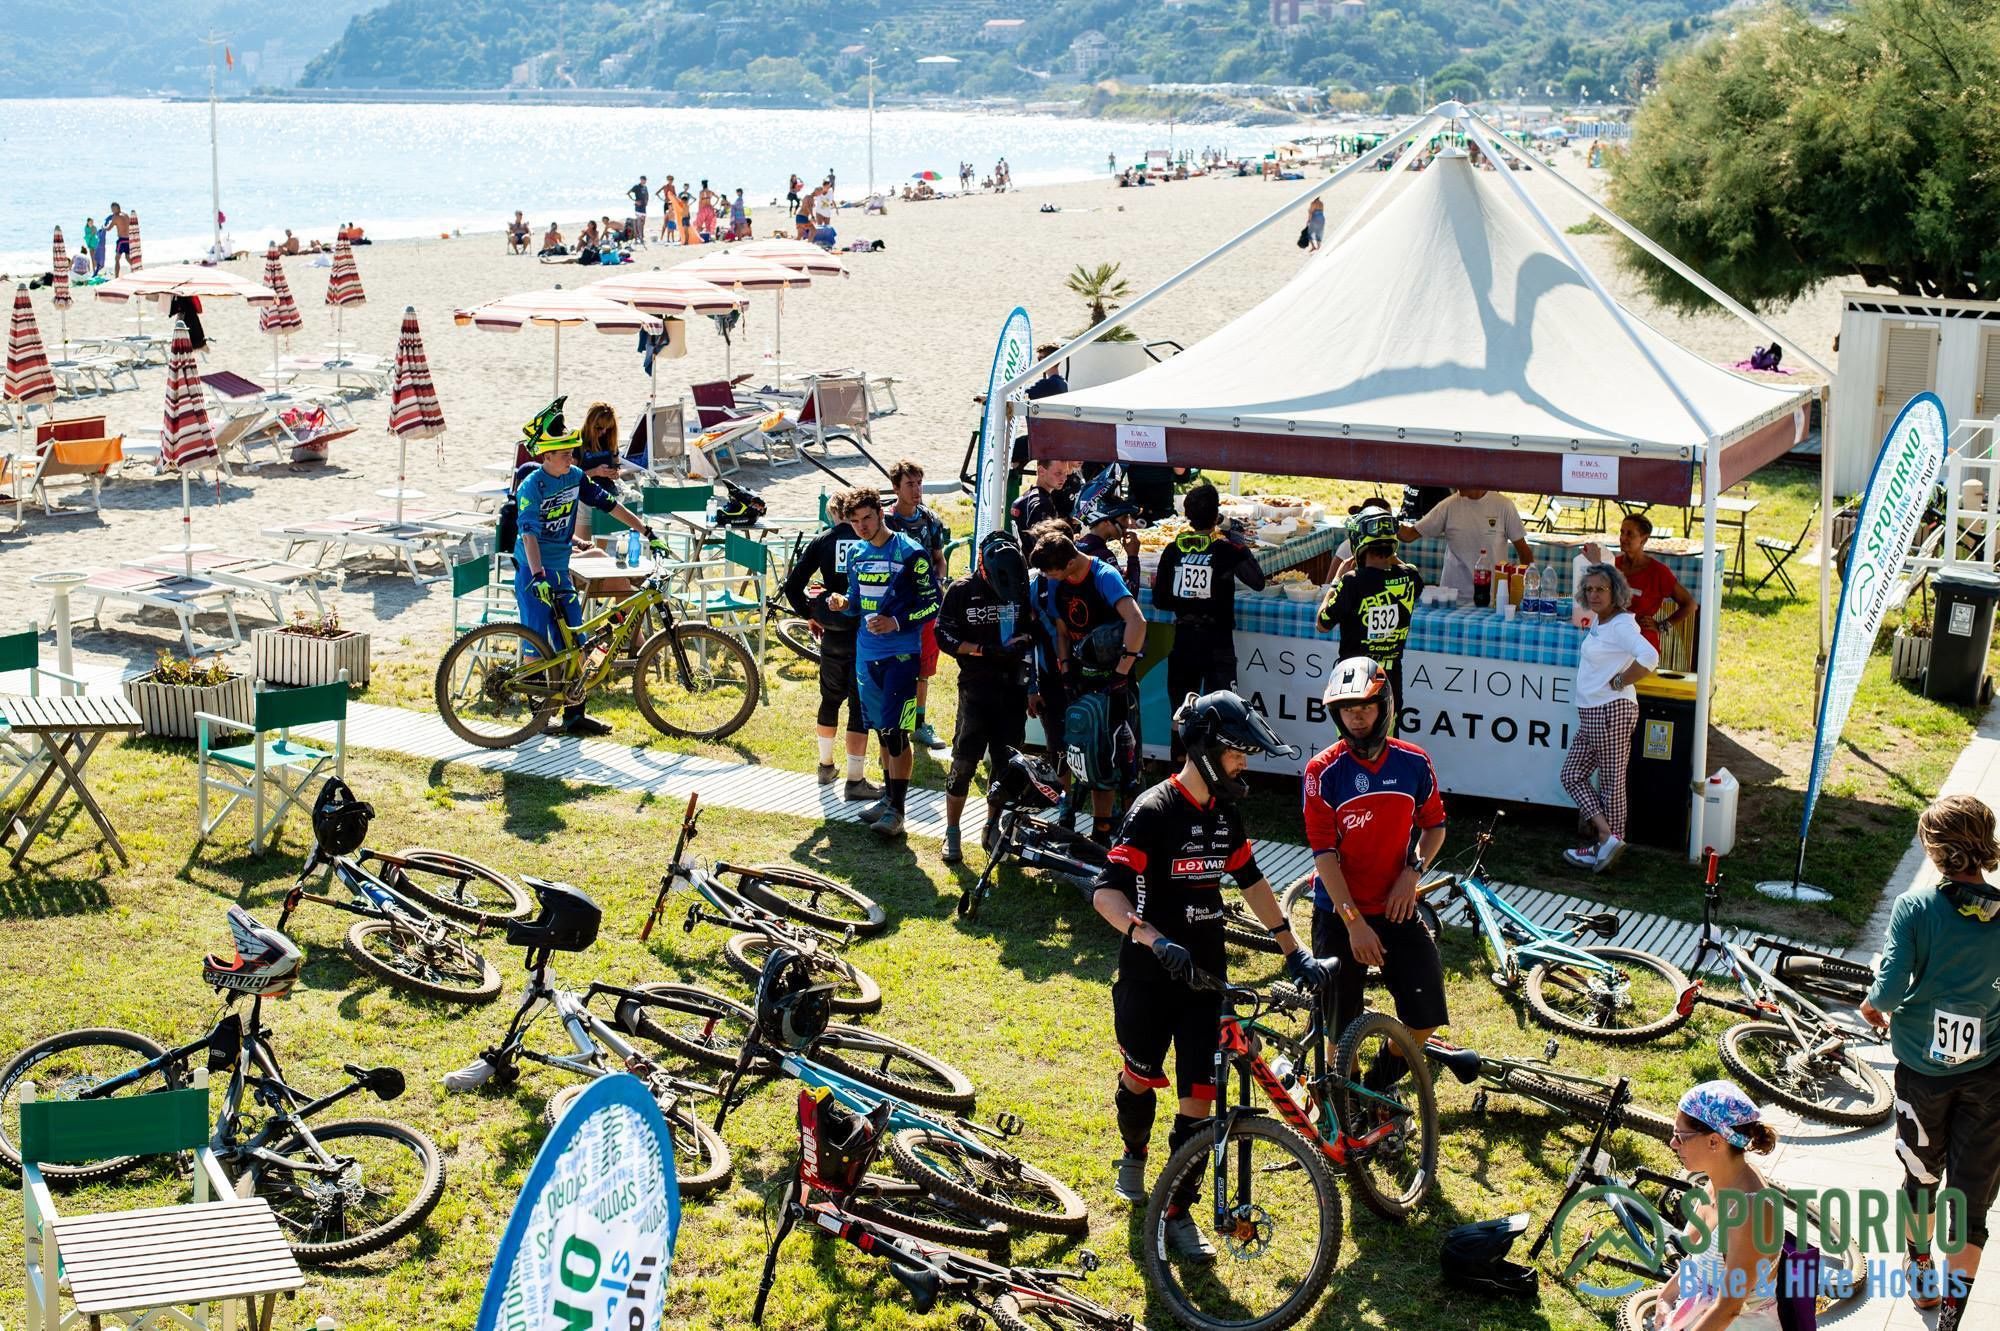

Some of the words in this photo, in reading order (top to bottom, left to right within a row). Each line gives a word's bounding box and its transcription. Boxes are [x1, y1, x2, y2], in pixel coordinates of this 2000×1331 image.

[1124, 440, 1158, 448] RISERVATO
[1571, 471, 1608, 480] RISERVATO
[1867, 427, 1921, 559] SPOTORNO
[1184, 567, 1208, 589] 523
[1372, 608, 1396, 630] 532
[1246, 647, 1573, 704] ASSAZIONE
[1248, 691, 1568, 750] ALBGATORI
[1938, 1016, 1975, 1054] 519
